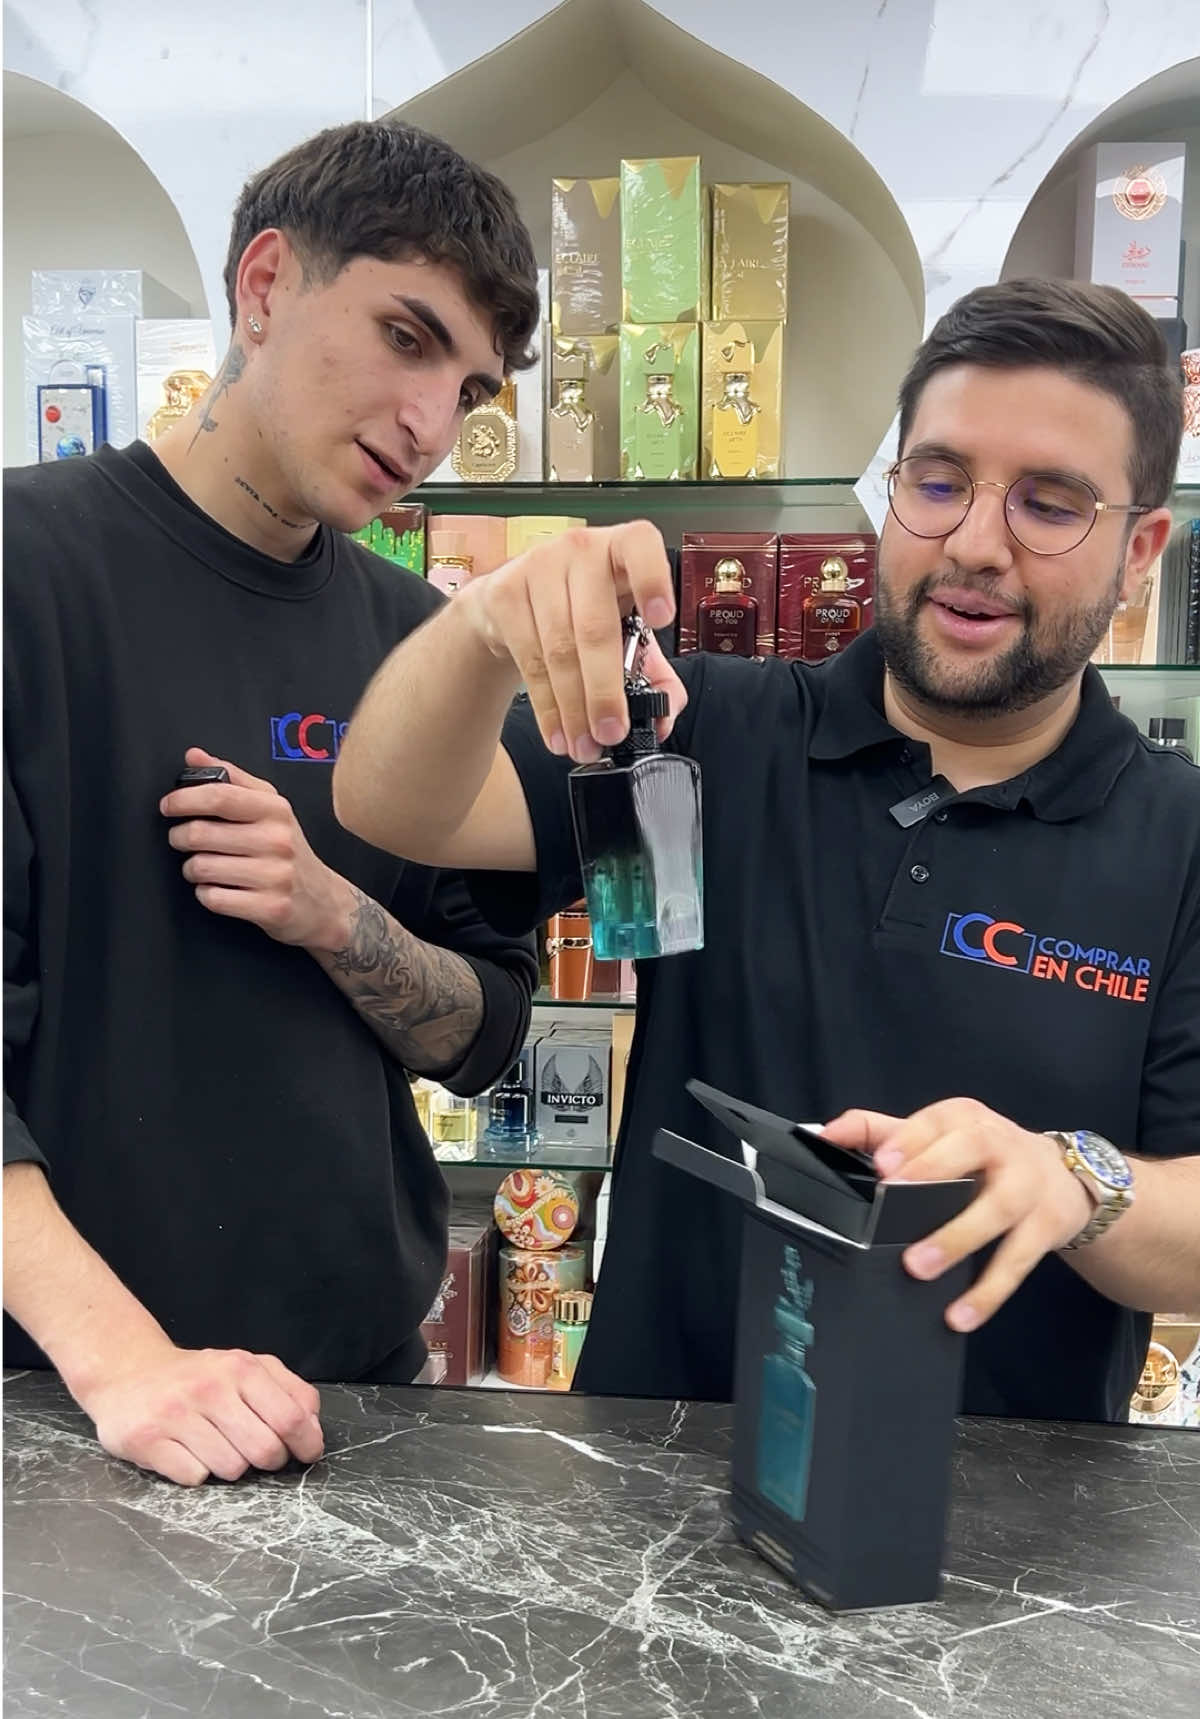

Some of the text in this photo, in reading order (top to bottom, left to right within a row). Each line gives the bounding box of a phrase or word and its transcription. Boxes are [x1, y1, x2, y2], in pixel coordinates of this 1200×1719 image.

[710, 609, 744, 619] PROUD
[815, 608, 850, 618] PROUD
[908, 792, 940, 812] BOYA
[1038, 936, 1151, 977] COMPRAR
[1032, 954, 1150, 1002] EN CHILE
[547, 1094, 597, 1105] INVICTO
